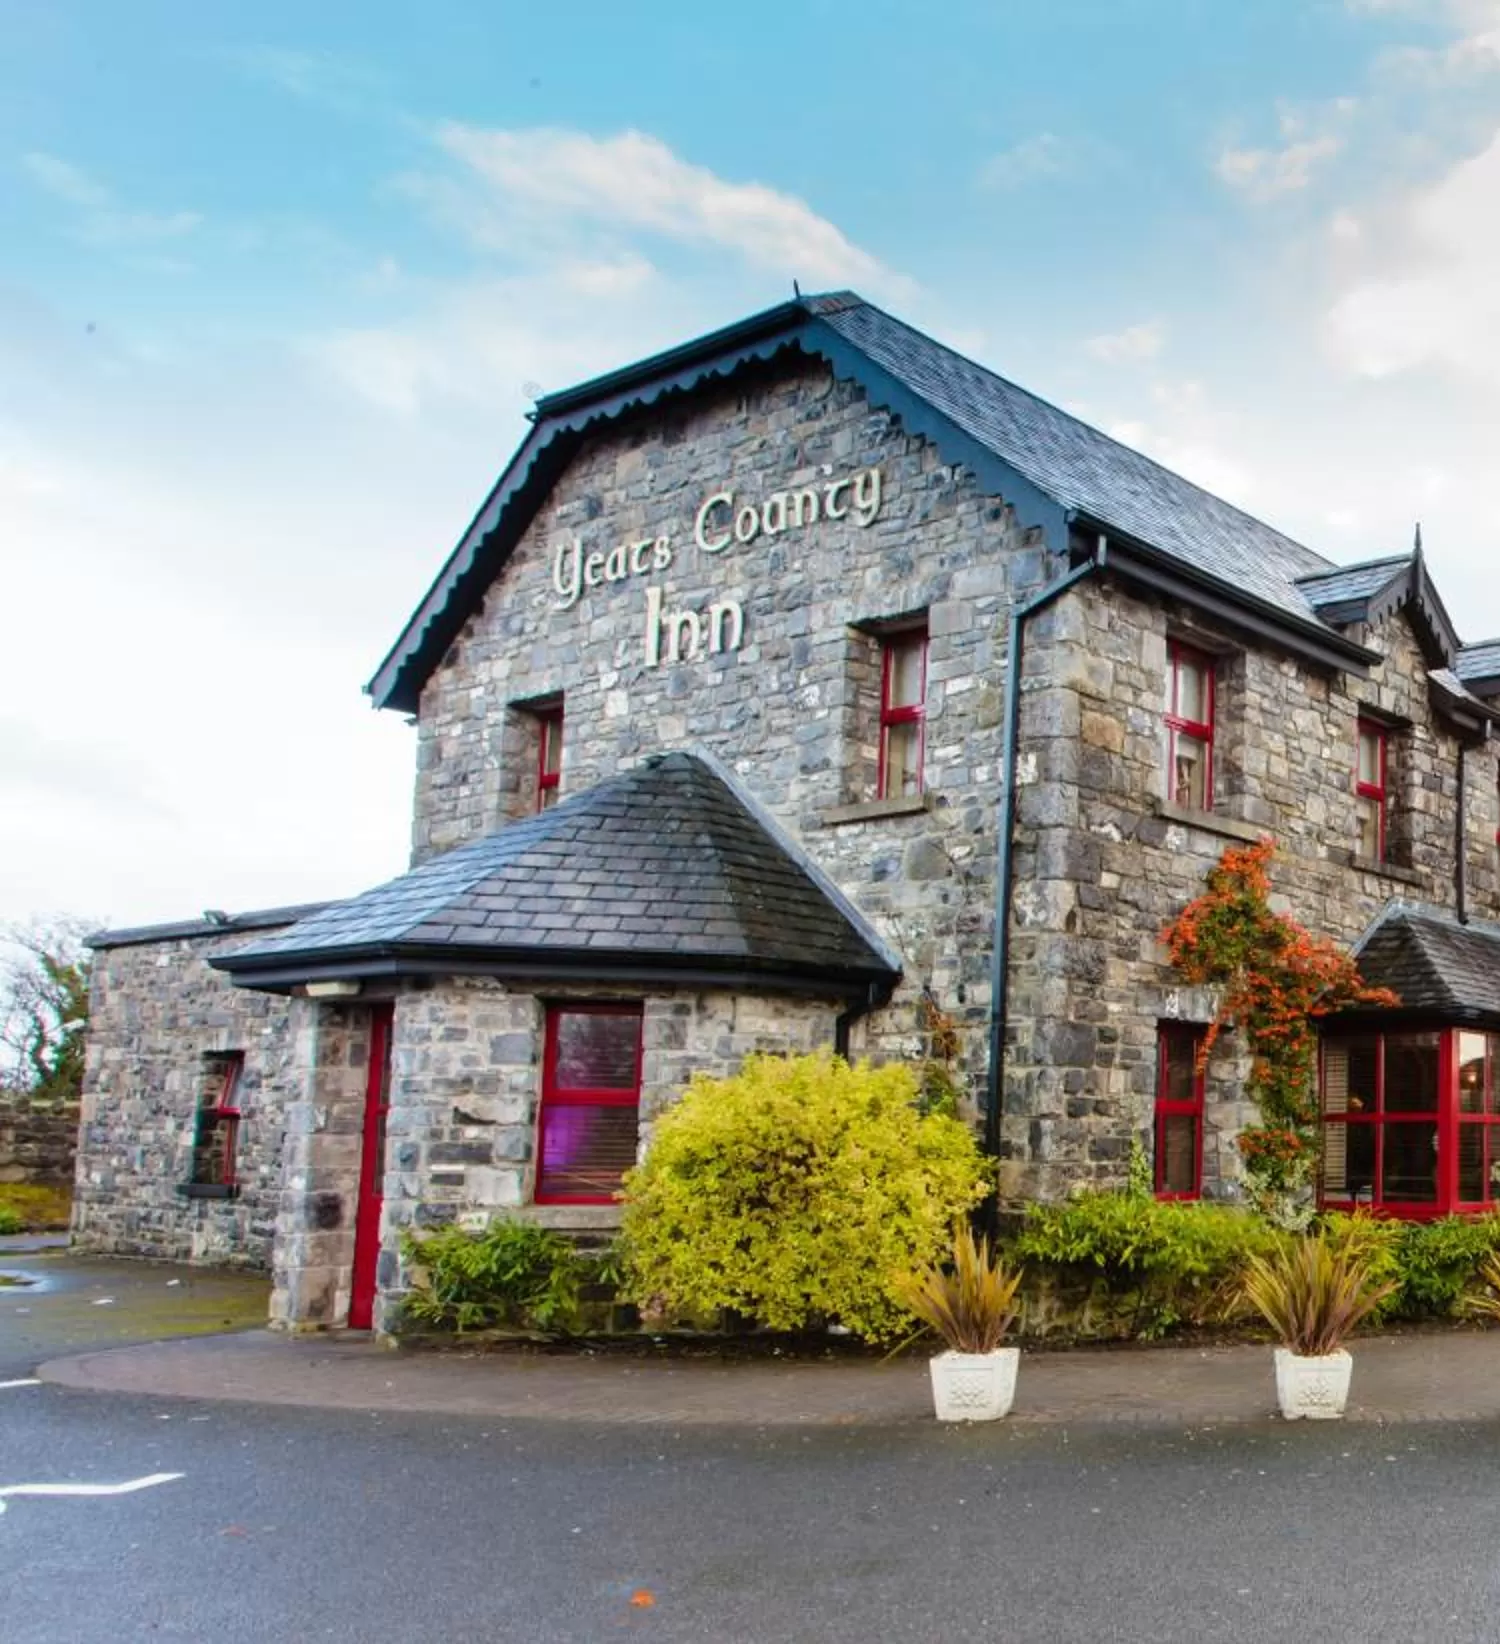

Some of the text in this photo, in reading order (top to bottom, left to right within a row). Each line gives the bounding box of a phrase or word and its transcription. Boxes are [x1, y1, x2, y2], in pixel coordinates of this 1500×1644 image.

[552, 467, 884, 611] Yeats County
[645, 585, 745, 667] Inn
